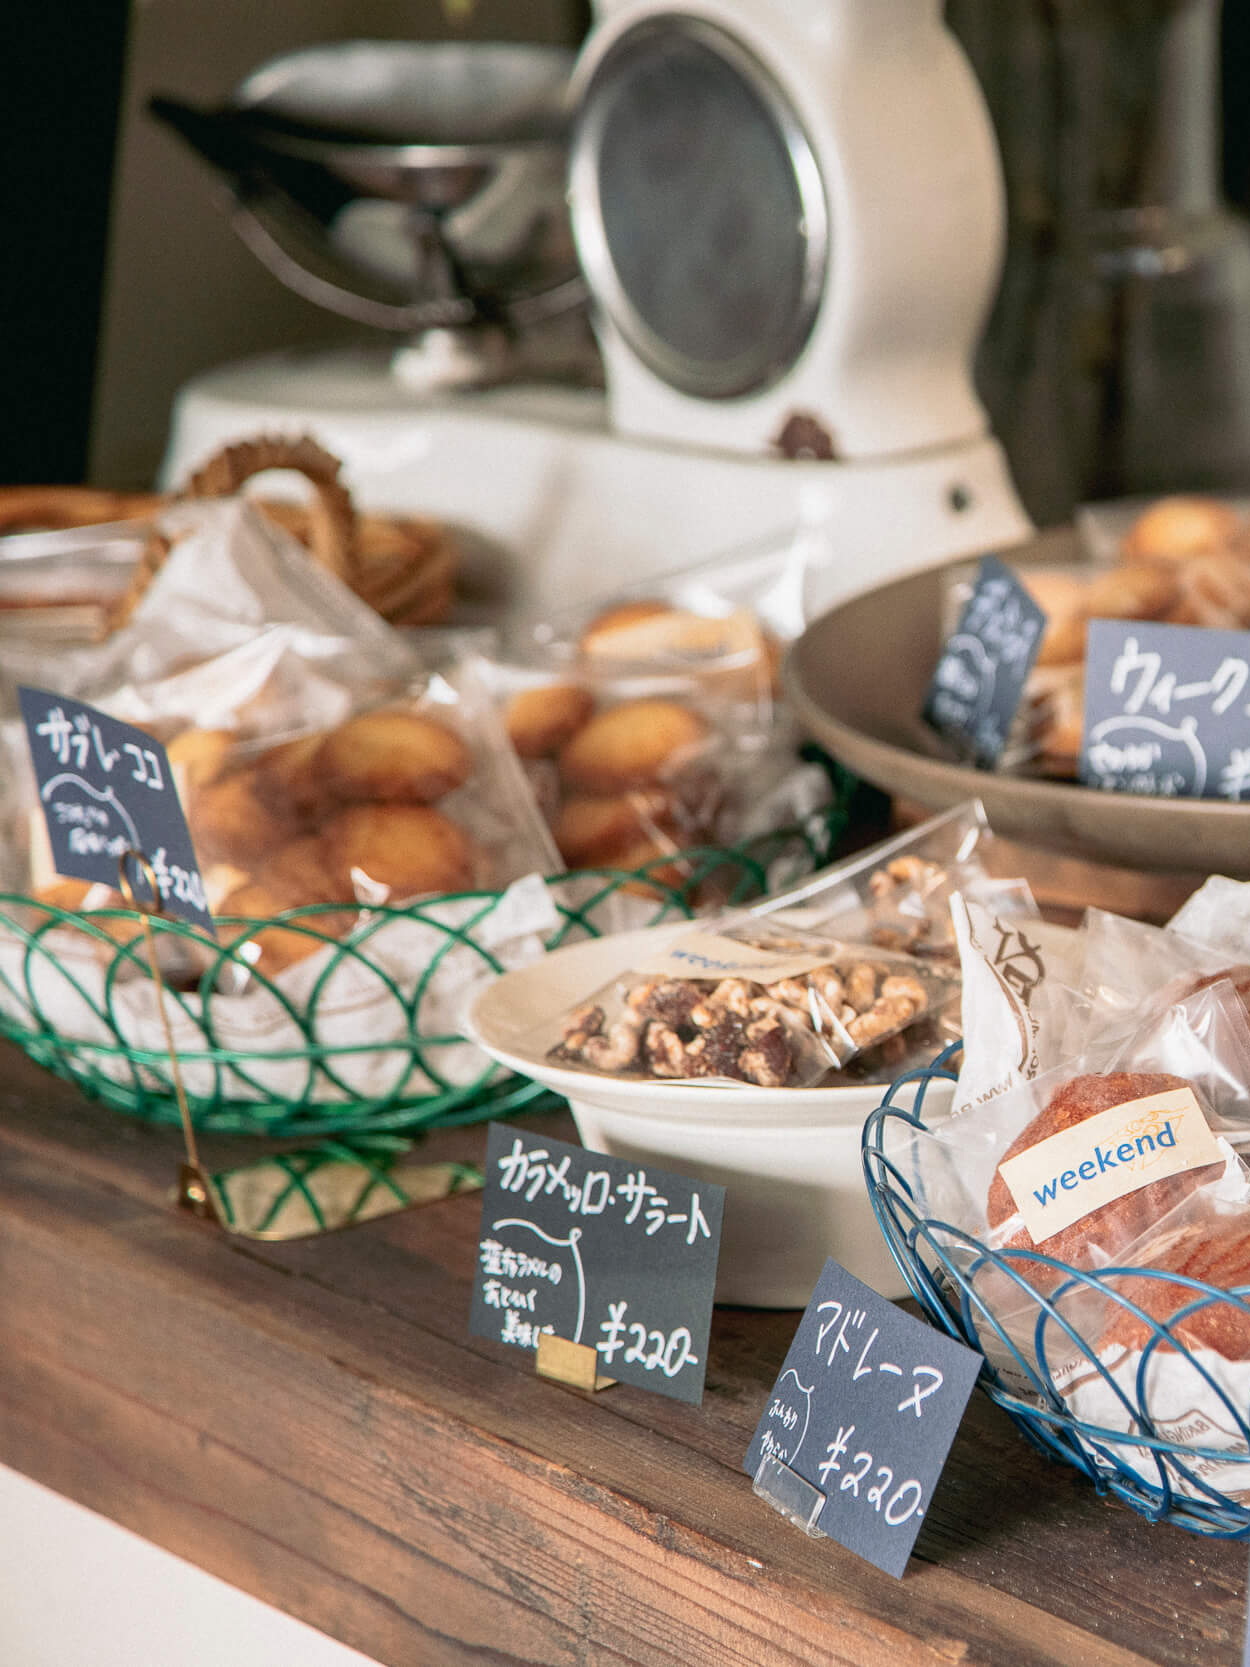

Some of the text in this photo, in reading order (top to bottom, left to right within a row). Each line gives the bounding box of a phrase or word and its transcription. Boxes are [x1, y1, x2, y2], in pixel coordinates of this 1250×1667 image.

[1032, 1121, 1177, 1207] weekend
[816, 1301, 944, 1417] マドレーヌ
